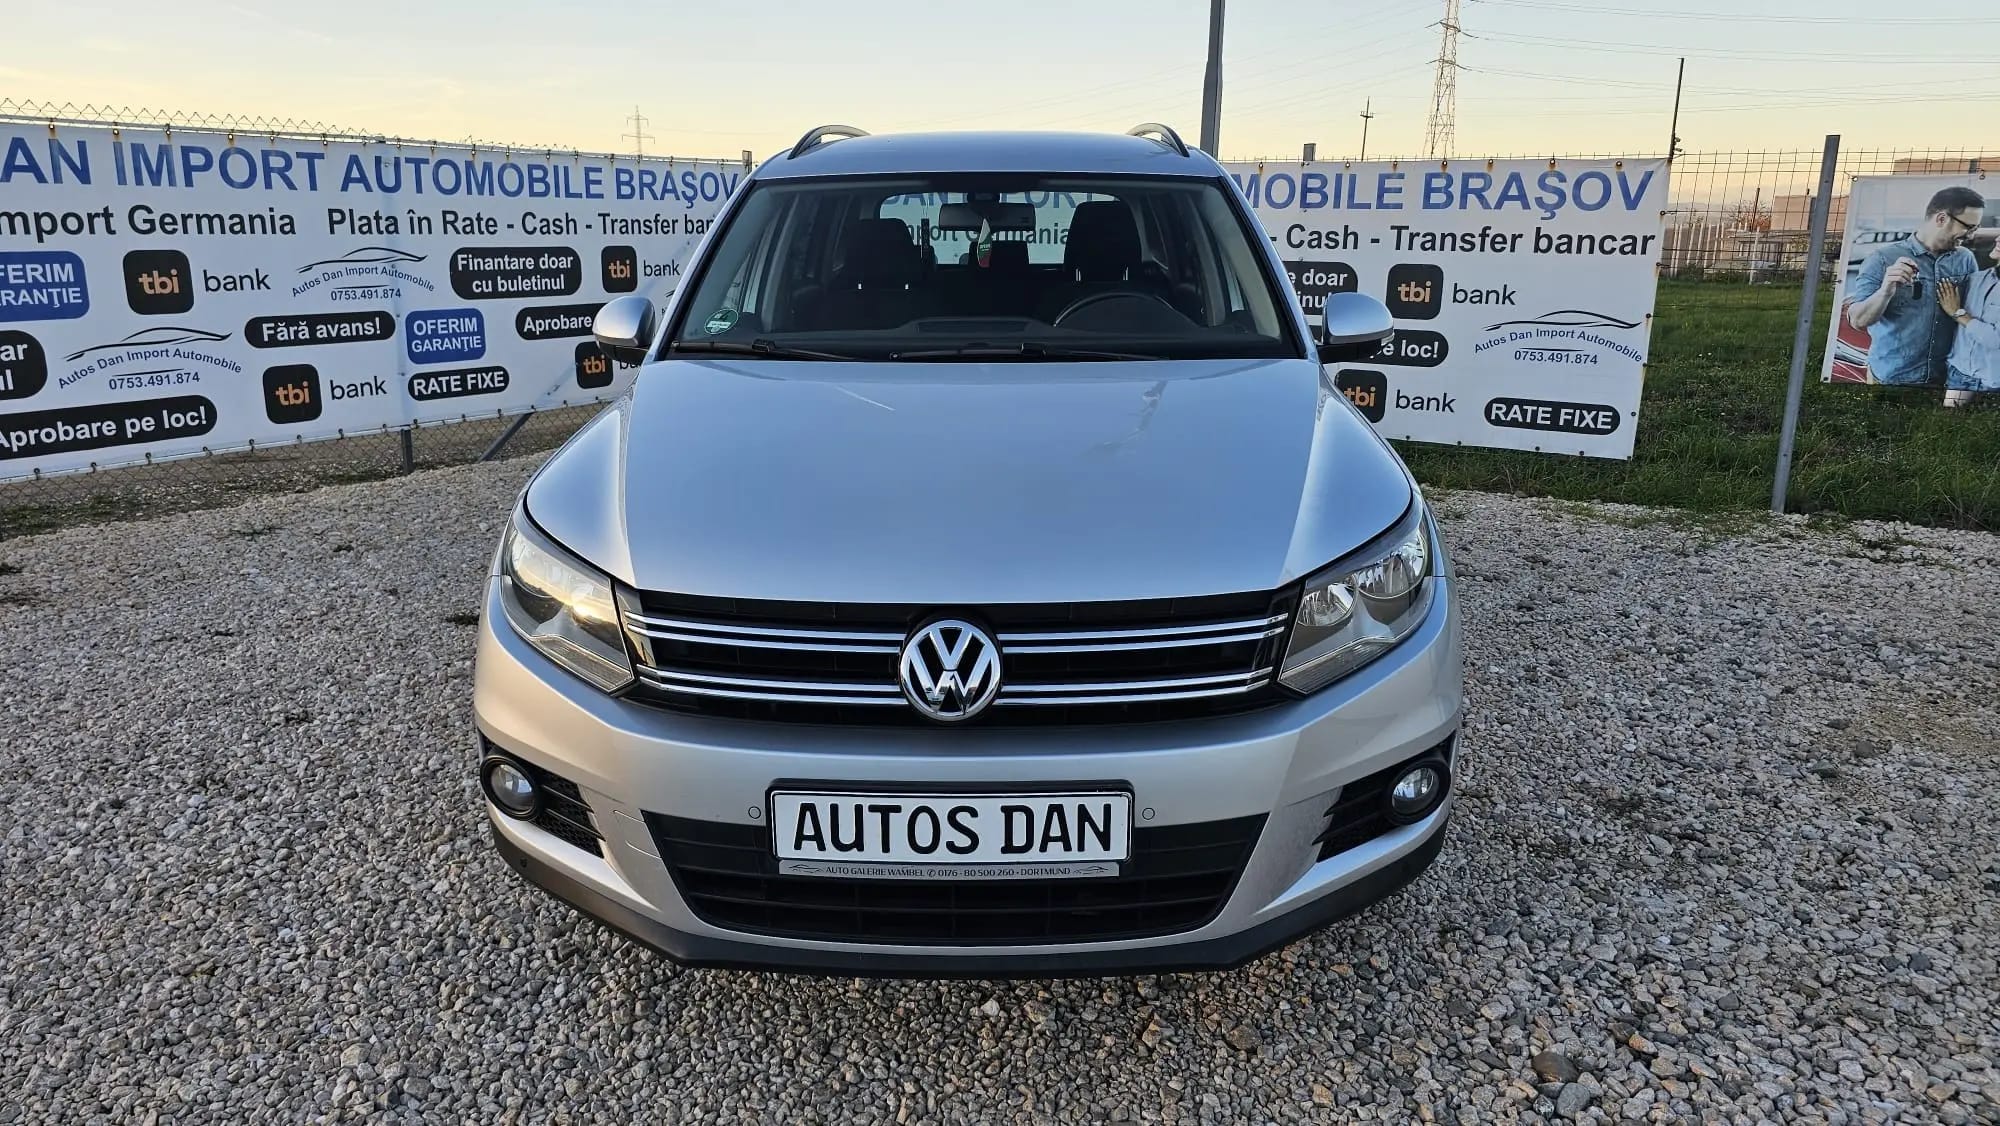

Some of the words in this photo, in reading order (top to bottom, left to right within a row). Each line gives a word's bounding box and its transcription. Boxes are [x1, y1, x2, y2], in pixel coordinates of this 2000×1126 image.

[0, 137, 92, 185] AN
[112, 141, 325, 192] IMPORT
[340, 153, 605, 200] AUTOMOBILE
[1230, 172, 1406, 210] MOBILE
[1422, 170, 1655, 220] BRAŞOV
[128, 204, 296, 236] Germania
[328, 207, 399, 236] Plata
[407, 209, 433, 235] în
[441, 210, 499, 236] Rate
[521, 211, 579, 236] Cash
[598, 212, 679, 236] Transfer
[1286, 223, 1359, 250] Cash
[1389, 225, 1524, 255] Transfer
[1532, 226, 1656, 258] bancar
[457, 253, 535, 272] Finantare
[539, 253, 574, 270] doar
[608, 260, 631, 279] tbi
[643, 260, 681, 278] bank
[138, 268, 180, 296] tbi
[203, 268, 271, 293] bank
[292, 276, 321, 298] Autos
[322, 269, 343, 282] Dan
[345, 265, 379, 277] Import
[380, 266, 436, 293] Automobile
[472, 278, 492, 293] cu
[497, 274, 565, 292] buletinul
[1302, 268, 1348, 287] doar
[330, 287, 402, 301] 0753.491.874
[1397, 281, 1432, 303] tbi
[1452, 283, 1516, 306] bank
[262, 321, 309, 342] Fără
[316, 317, 382, 339] avans!
[413, 317, 478, 336] OFERIM
[523, 314, 592, 336] Aprobare
[1400, 339, 1439, 358] loc!
[1474, 335, 1507, 353] Autos
[1509, 330, 1533, 341] Dan
[1536, 328, 1575, 339] Import
[1577, 330, 1643, 363] Automobile
[1514, 350, 1598, 365] 0753.491.874
[58, 364, 96, 390] Autos
[97, 354, 124, 370] Dan
[127, 348, 170, 361] Import
[173, 348, 242, 374] Automobile
[583, 354, 605, 375] tbi
[108, 371, 200, 391] 0753.491.874
[275, 381, 310, 407] tbi
[330, 376, 387, 401] bank
[413, 375, 462, 397] RATE
[466, 371, 505, 390] FIXE
[1344, 386, 1376, 407] tbi
[1395, 389, 1456, 414] bank
[125, 416, 156, 439] pe
[162, 405, 207, 429] loc!
[1490, 403, 1551, 426] RATE
[1559, 407, 1613, 430] FIXE
[793, 802, 980, 855] AUTOS
[1000, 803, 1113, 855] DAN
[825, 866, 849, 874] AUTO
[850, 866, 886, 876] GALERIE
[887, 867, 925, 877] WAMBEL
[937, 869, 958, 877] 0176
[1020, 867, 1071, 876] DORTMUND
